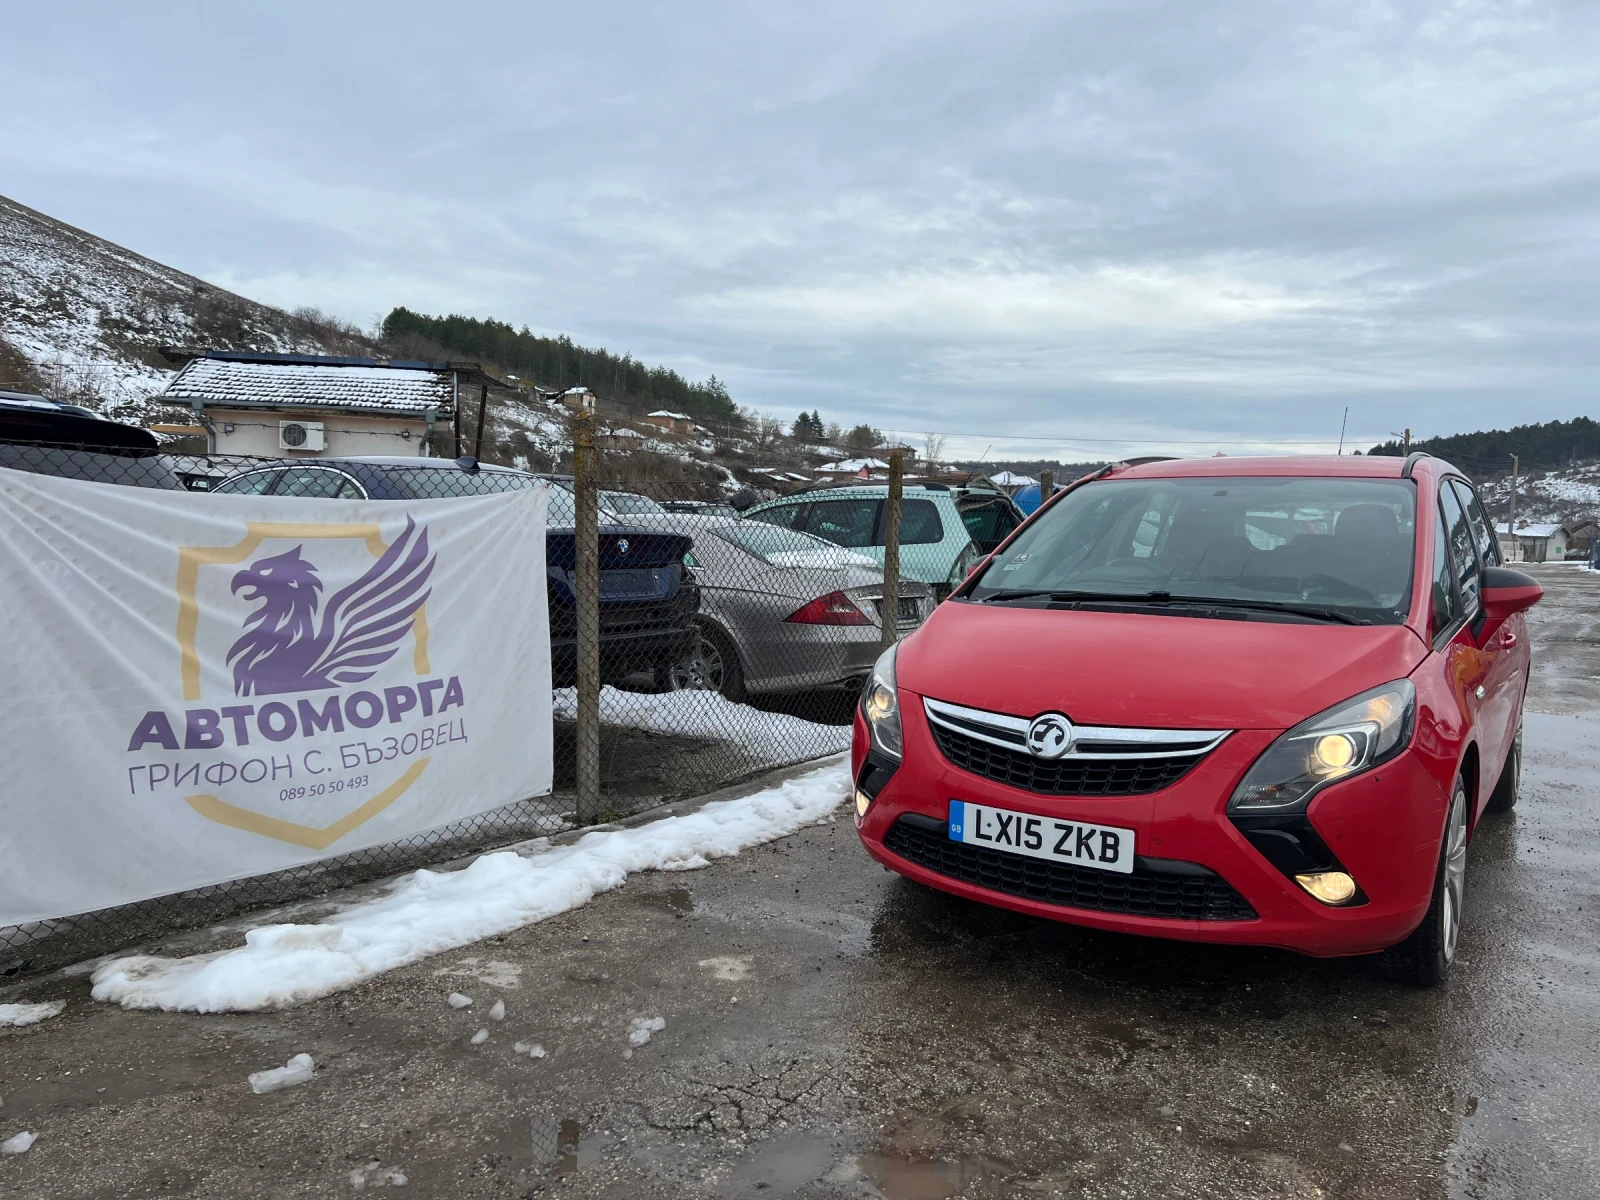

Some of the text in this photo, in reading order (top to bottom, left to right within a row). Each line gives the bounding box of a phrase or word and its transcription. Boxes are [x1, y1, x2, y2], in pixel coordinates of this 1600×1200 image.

[127, 676, 464, 751] АВТОМОРГА
[128, 717, 468, 795] ГРИФОН С. БЪЗОВЕЦ
[279, 774, 369, 801] 089 50 50 493
[951, 824, 962, 833] GB
[975, 809, 1120, 864] LX15 ZKB
